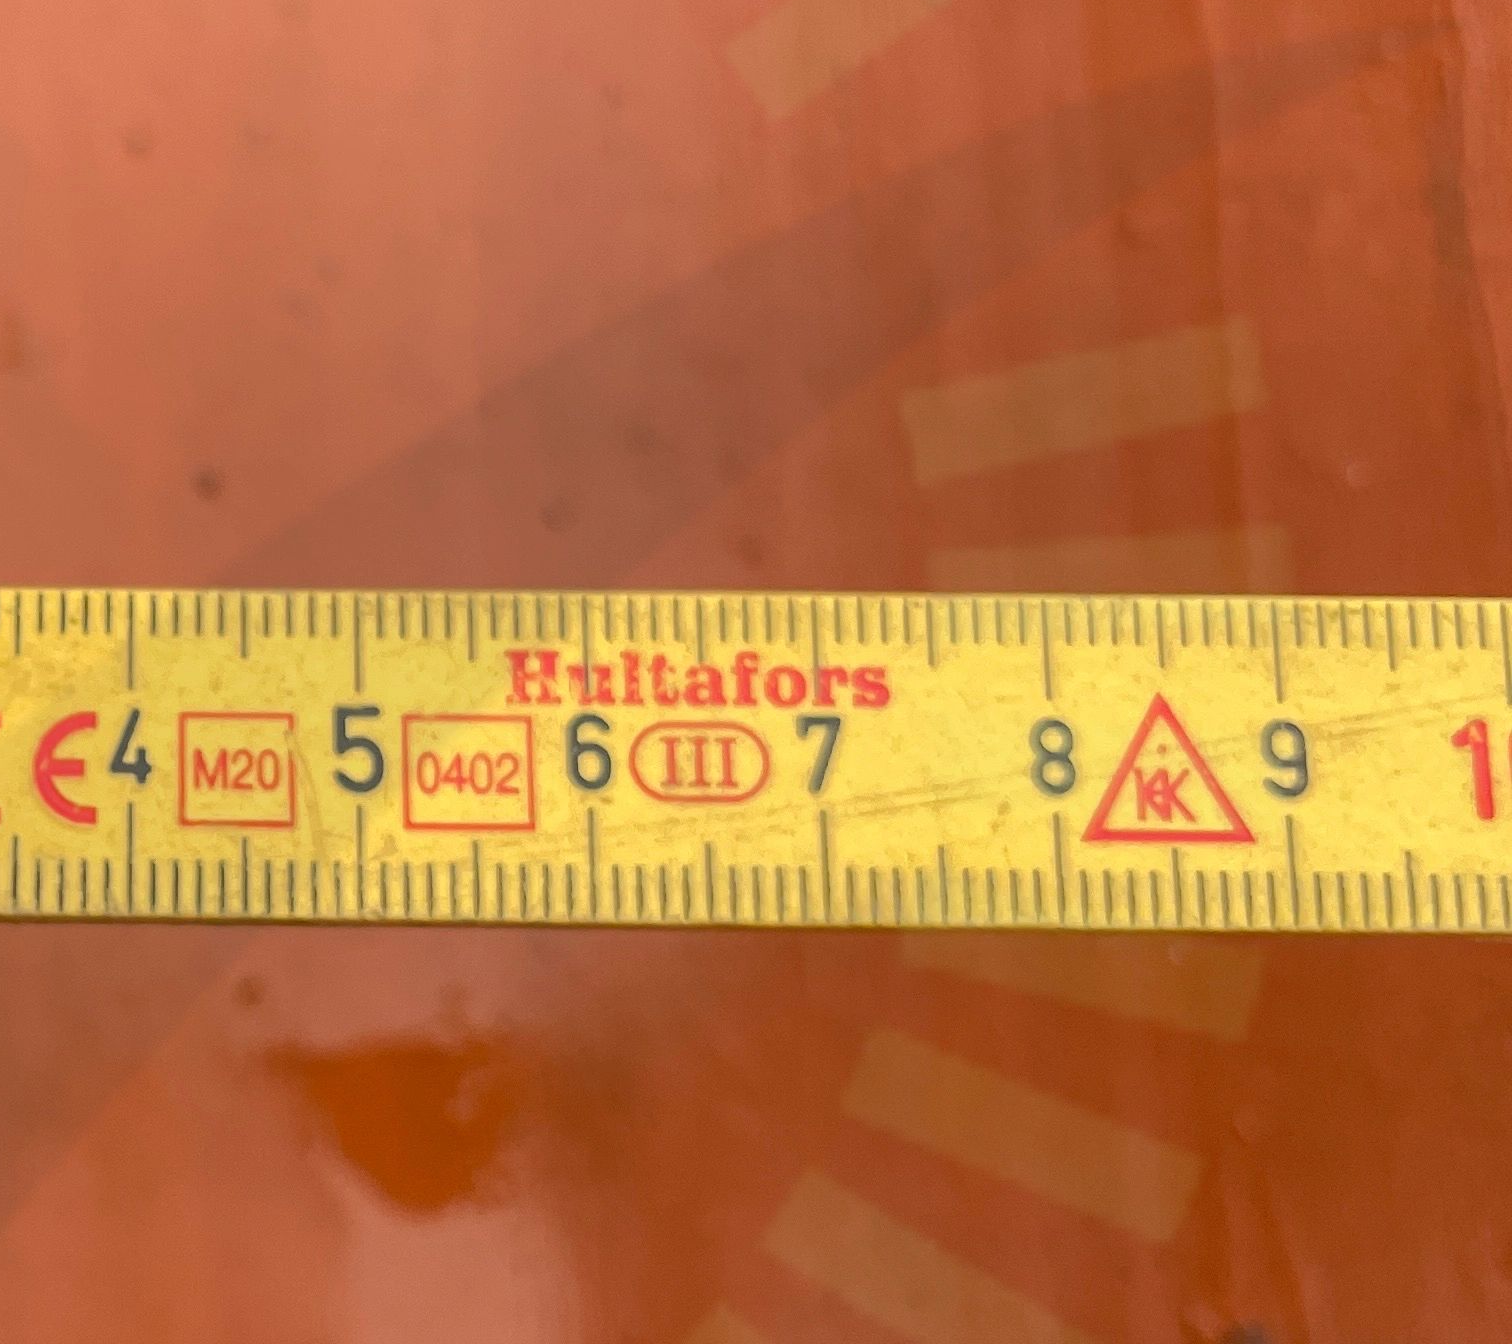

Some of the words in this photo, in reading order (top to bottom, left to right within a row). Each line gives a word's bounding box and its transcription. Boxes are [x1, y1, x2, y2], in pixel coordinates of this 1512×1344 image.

[504, 650, 890, 708] Hultafors
[110, 708, 152, 783] 4
[332, 706, 385, 793] 5
[567, 713, 613, 791] 6
[795, 716, 842, 794] 7
[1029, 719, 1076, 796] 8
[1261, 720, 1309, 797] 9
[1450, 717, 1512, 822] 1
[191, 748, 280, 792] M20
[415, 751, 521, 796] 0402
[658, 736, 740, 790] III
